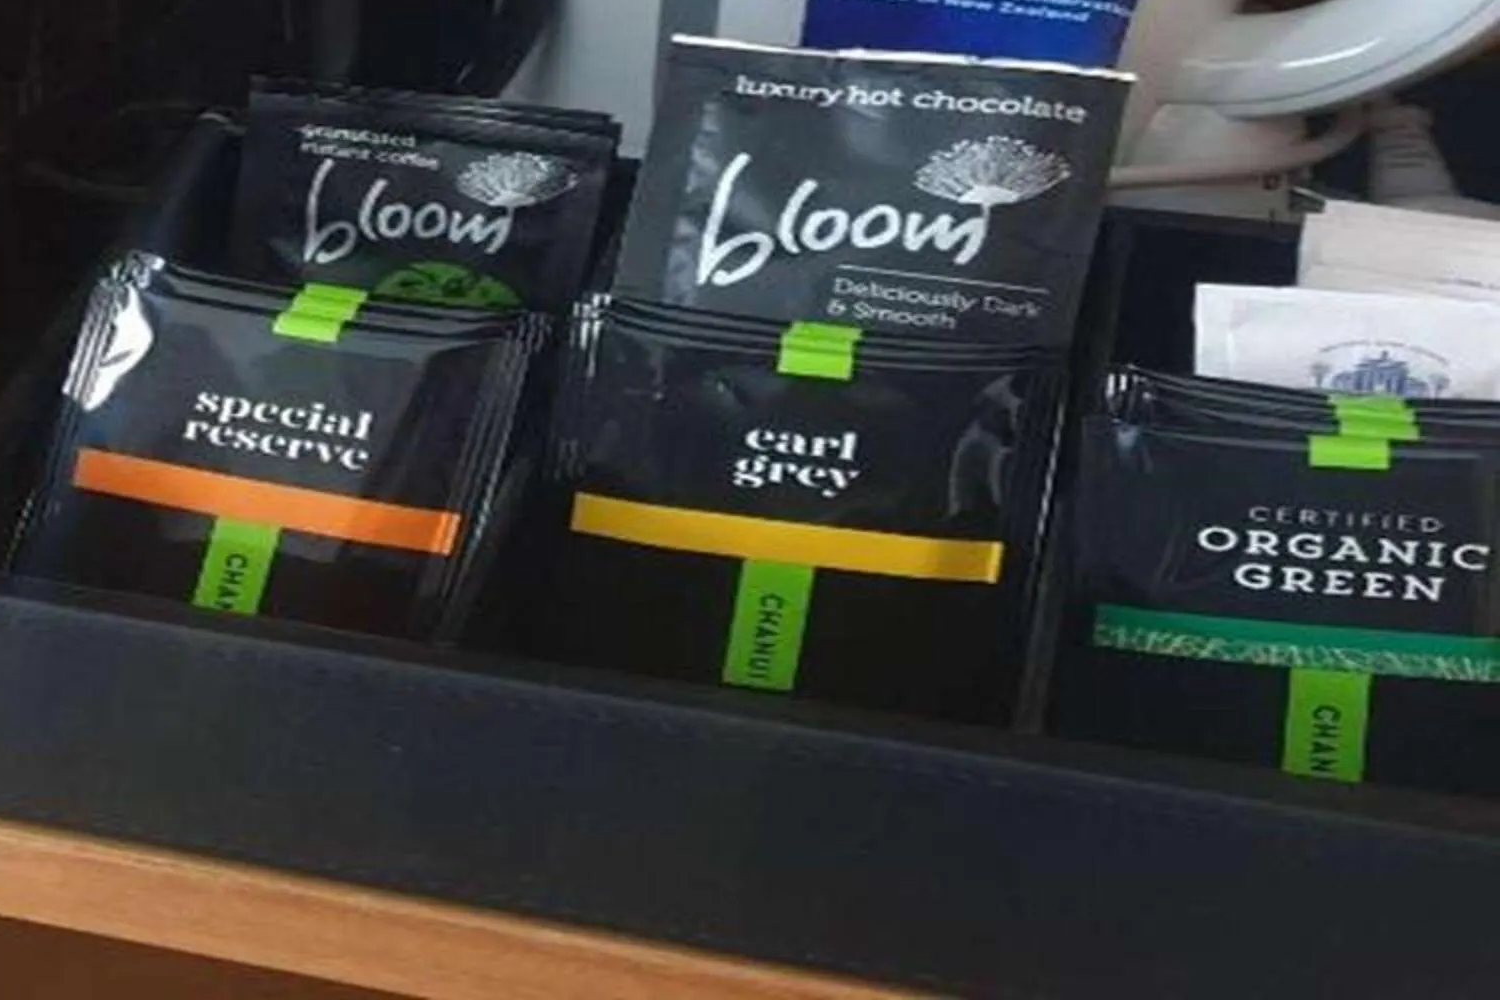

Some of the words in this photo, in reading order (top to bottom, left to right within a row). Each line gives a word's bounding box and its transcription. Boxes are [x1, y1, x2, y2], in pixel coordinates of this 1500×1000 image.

[998, 1, 1091, 24] Zealand
[735, 74, 843, 108] luxury
[845, 85, 905, 108] hot
[912, 88, 1087, 125] chocolate
[302, 157, 513, 265] bloom
[694, 151, 991, 287] bloom
[832, 276, 975, 314] Deliciously
[982, 294, 1043, 319] Dark
[852, 301, 957, 330] Smooth
[195, 389, 375, 442] special
[182, 417, 371, 472] reserve
[744, 426, 859, 461] earl
[731, 453, 860, 498] grey
[1247, 505, 1446, 534] CERTIFIED
[1197, 524, 1492, 572] ORGANIC
[1232, 561, 1448, 602] GREEN
